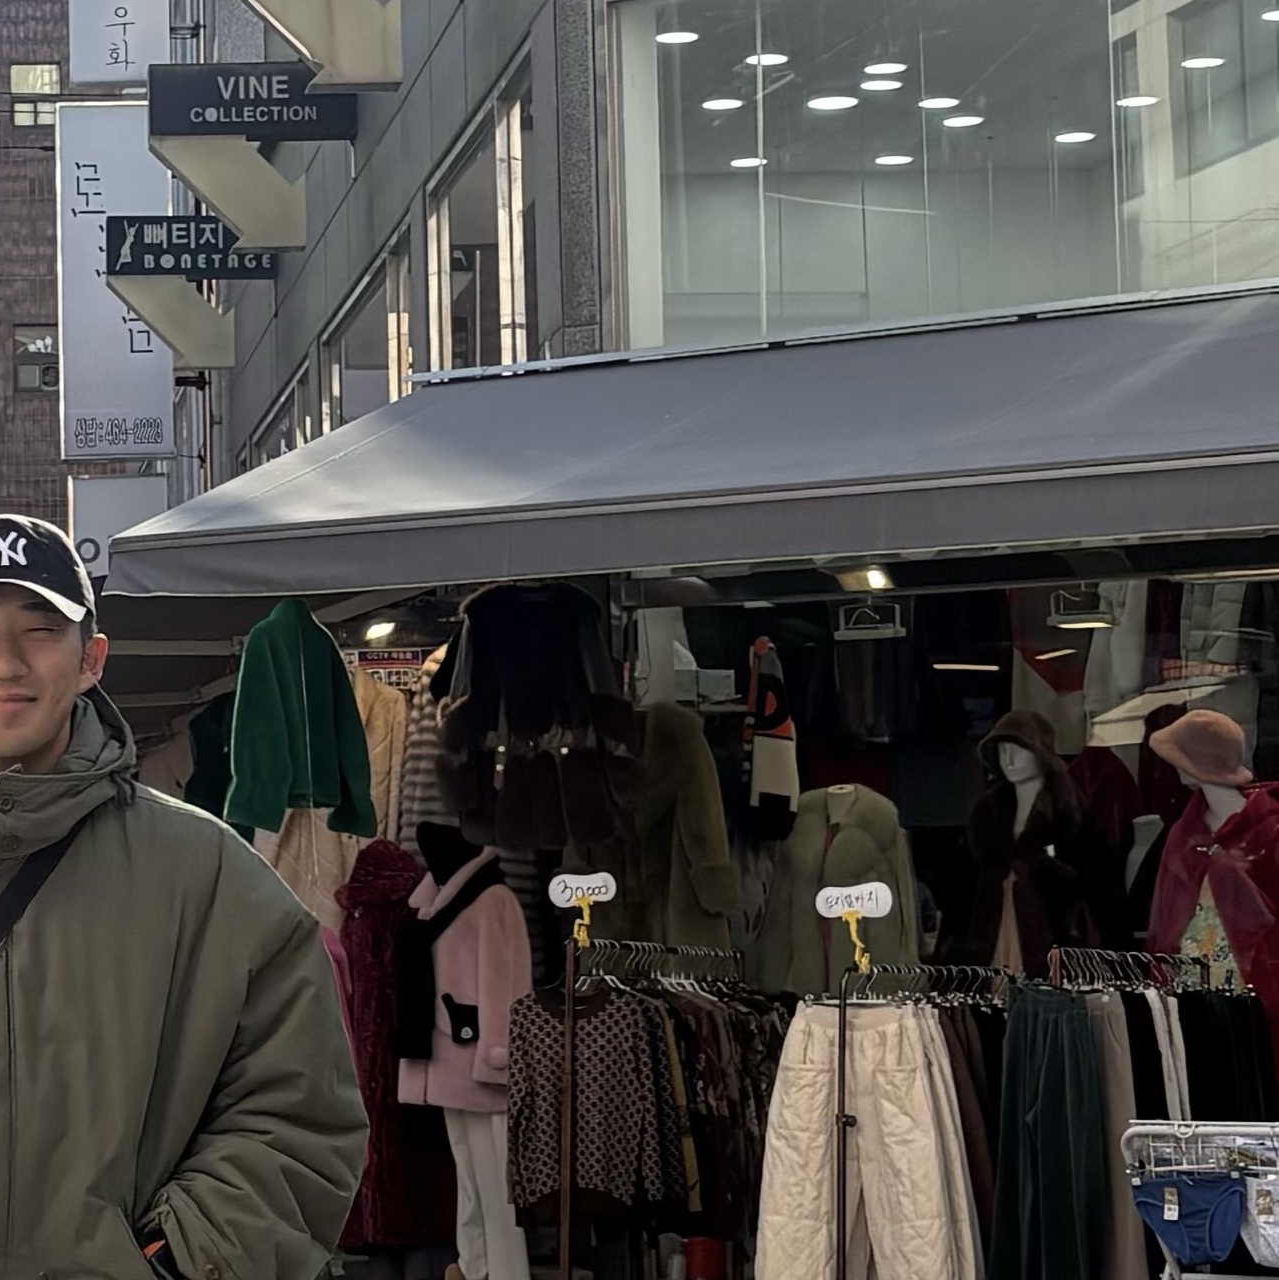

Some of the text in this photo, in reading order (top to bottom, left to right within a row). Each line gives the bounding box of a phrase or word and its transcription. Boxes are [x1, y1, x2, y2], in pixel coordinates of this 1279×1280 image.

[217, 75, 289, 100] VINE
[190, 105, 317, 123] COLLECTION
[144, 253, 271, 269] BONETAGE
